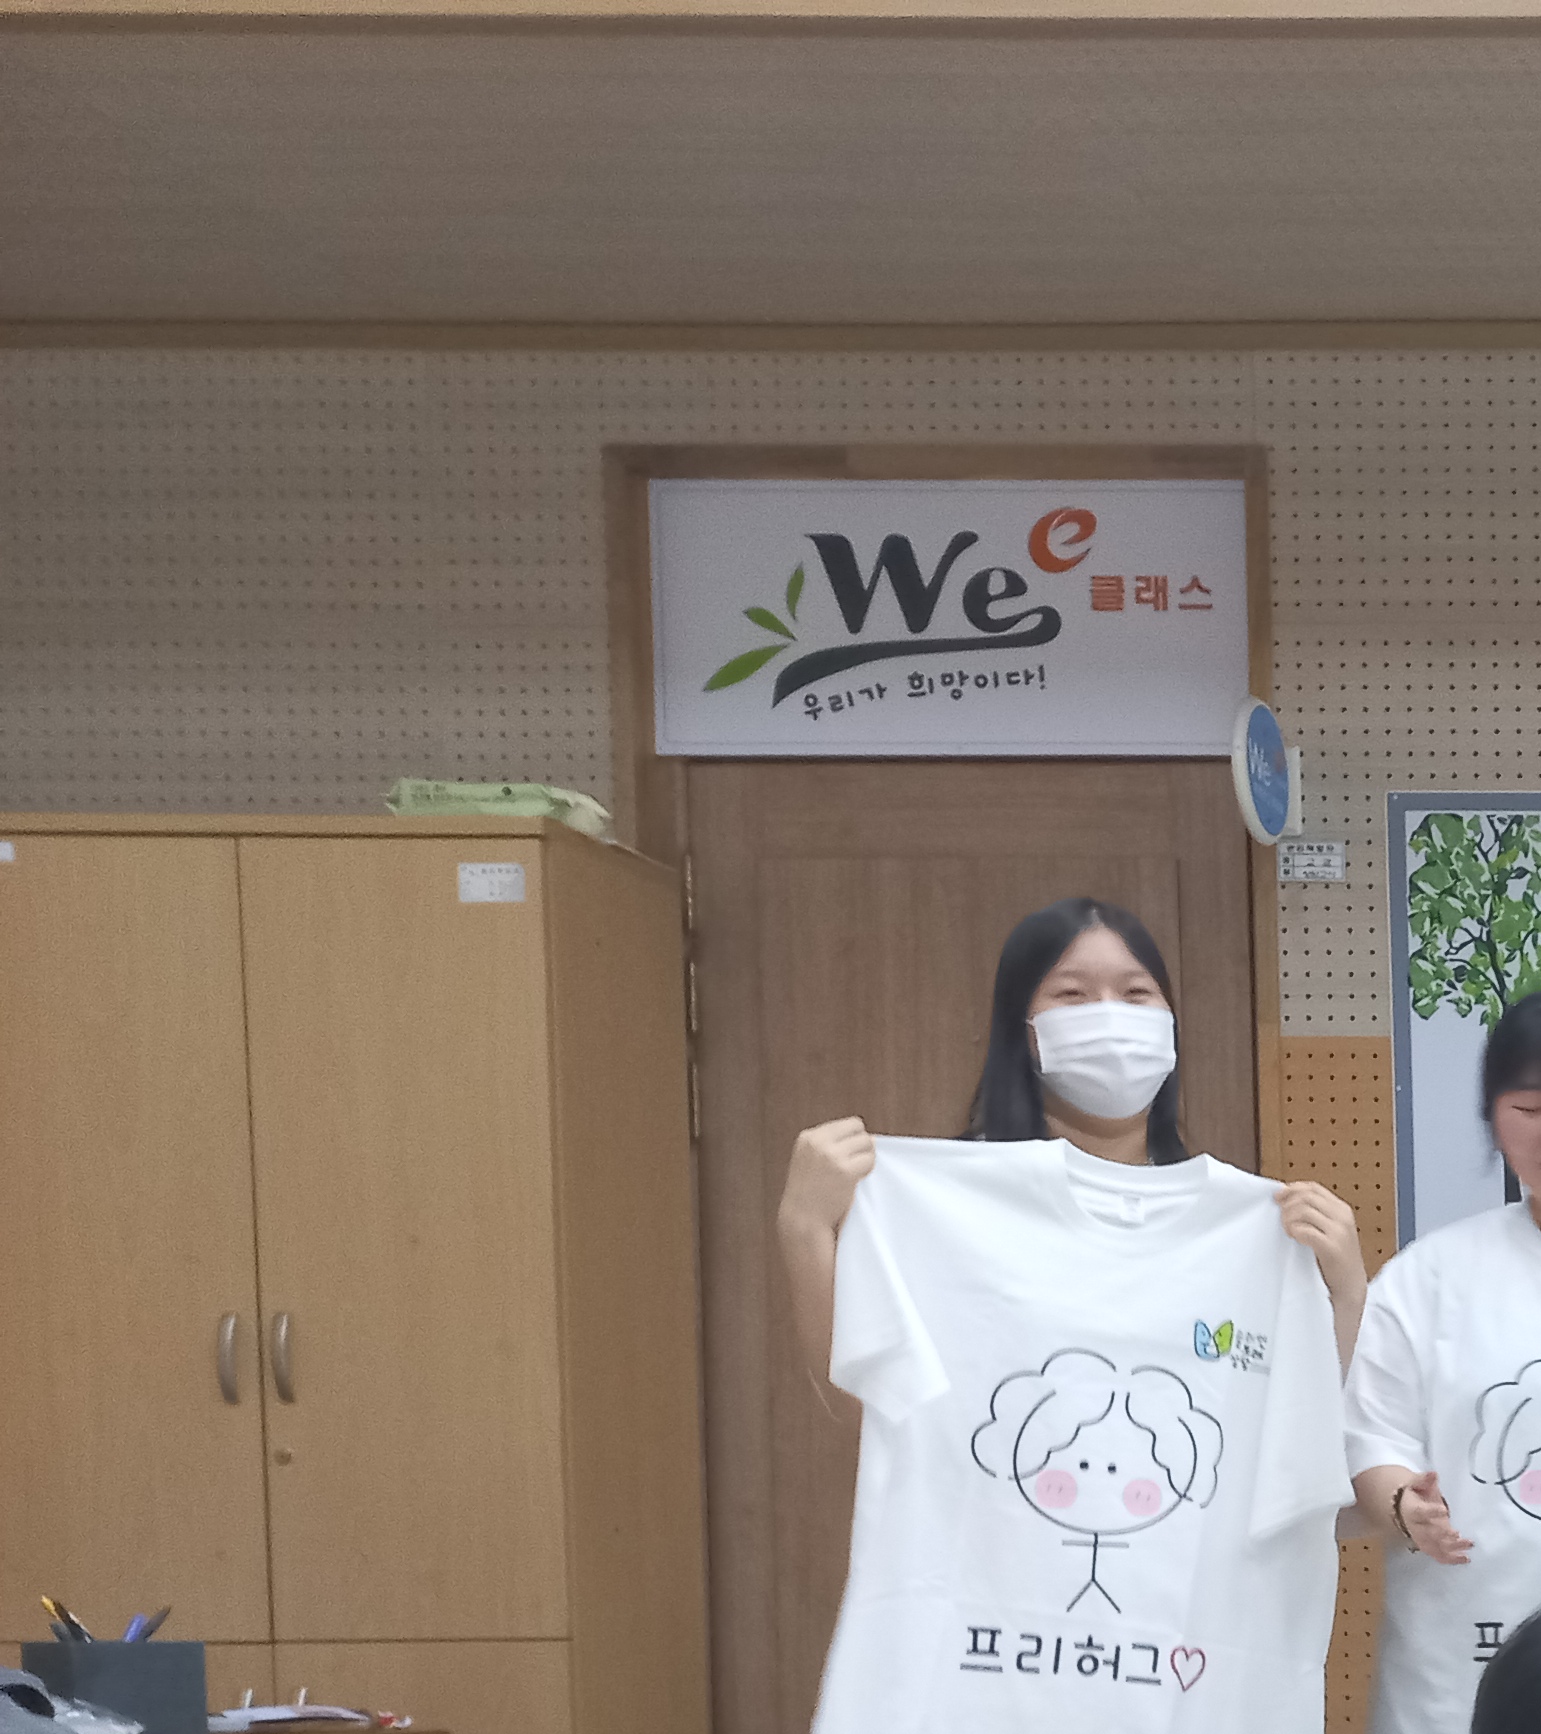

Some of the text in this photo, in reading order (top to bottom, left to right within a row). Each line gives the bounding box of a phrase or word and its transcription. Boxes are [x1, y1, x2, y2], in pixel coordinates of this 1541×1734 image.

[805, 530, 1062, 647] We
[1089, 574, 1214, 613] 클래스
[803, 664, 1046, 721] 우리가 희망이다!
[959, 1625, 1163, 1687] 프리허그
